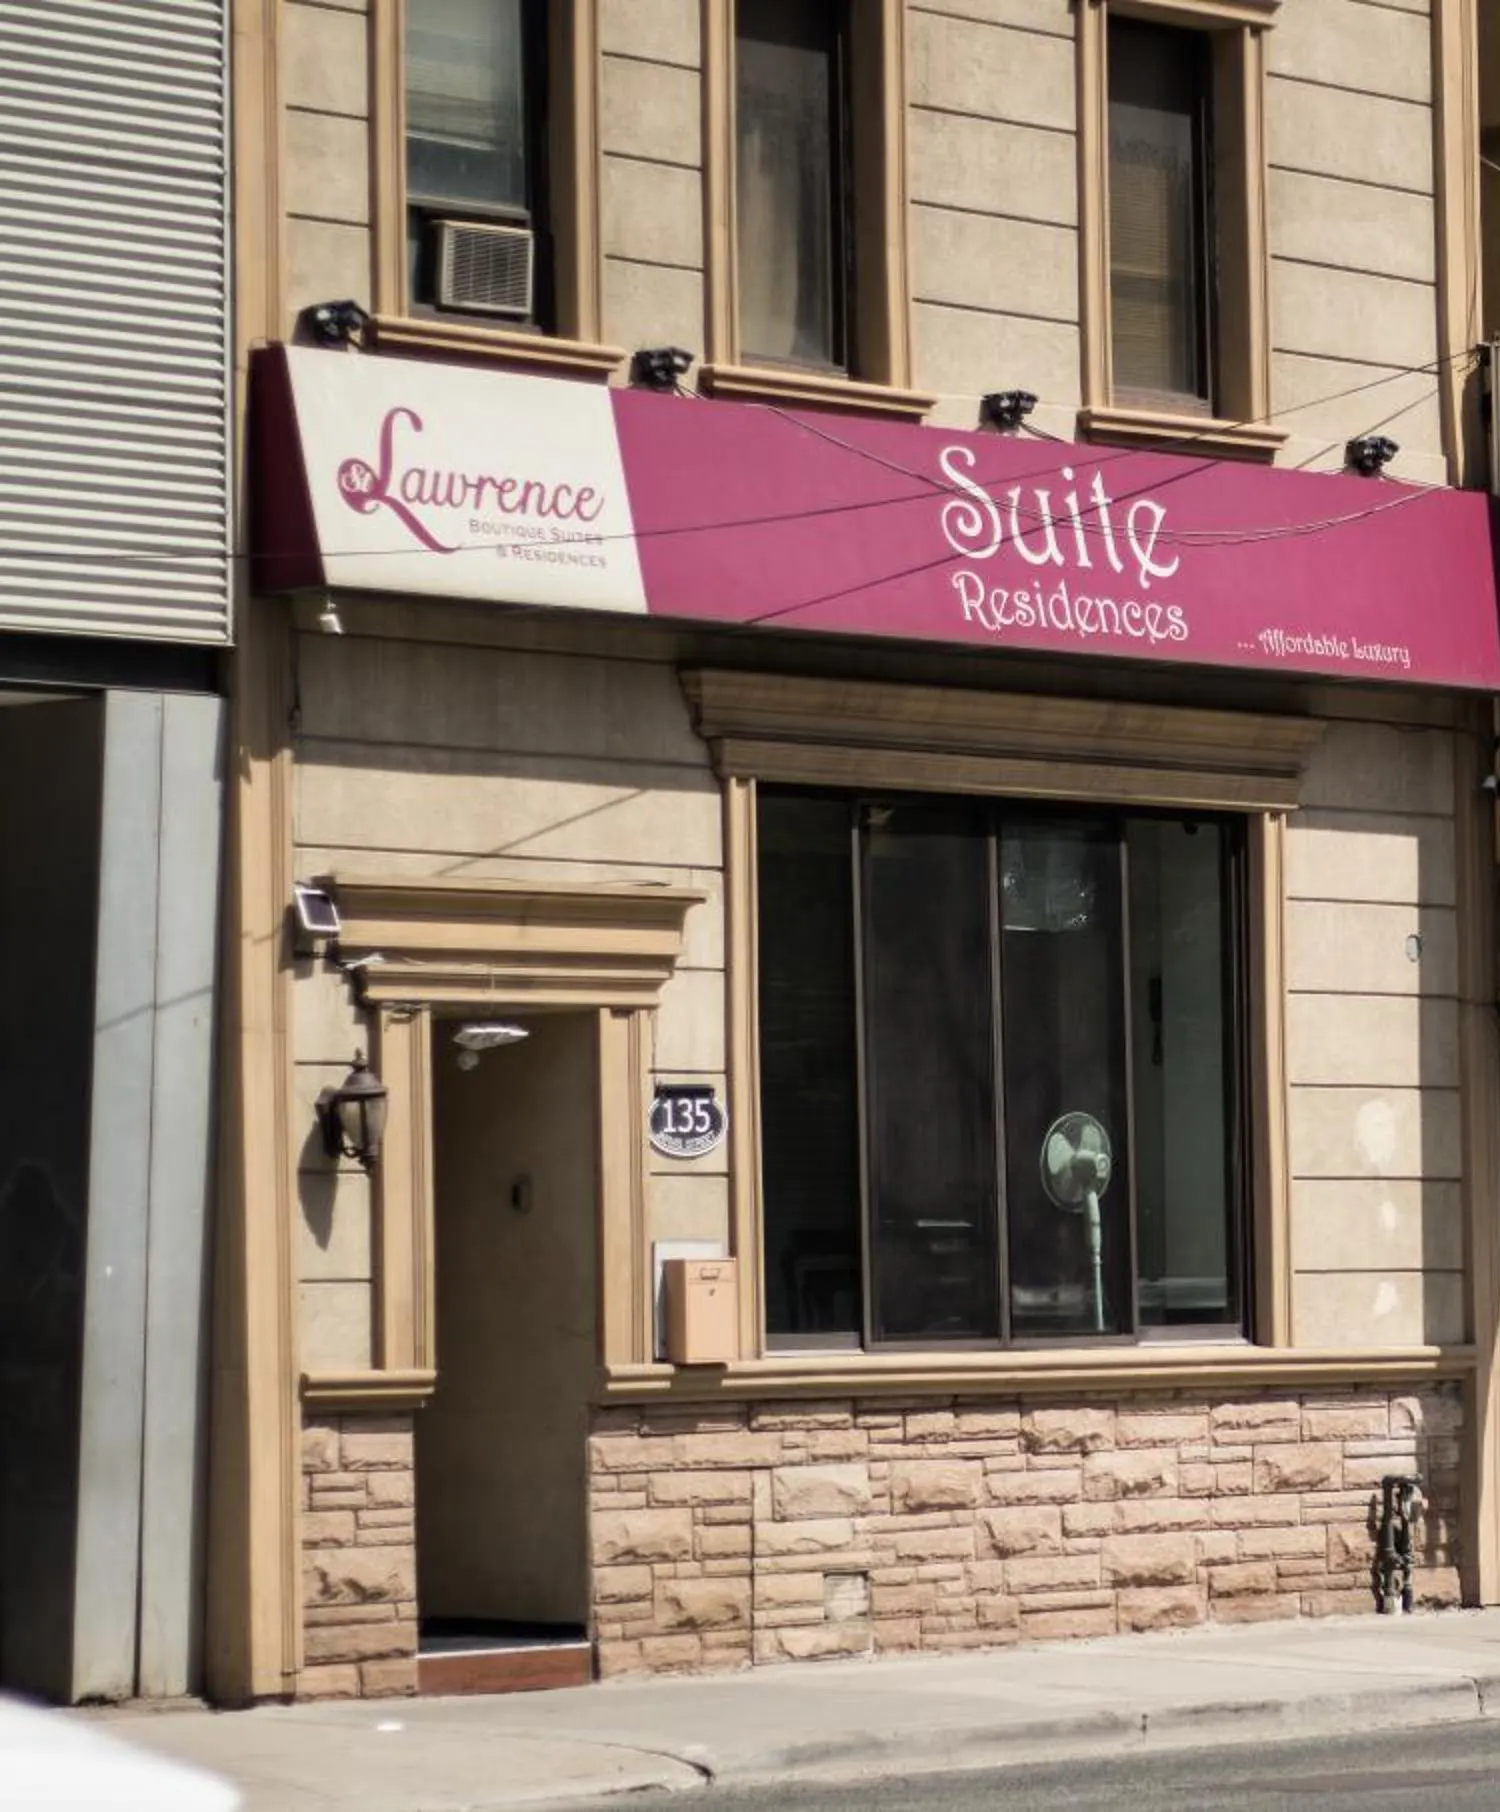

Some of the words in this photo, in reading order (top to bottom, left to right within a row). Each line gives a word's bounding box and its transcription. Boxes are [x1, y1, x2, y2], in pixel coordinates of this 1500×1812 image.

[338, 407, 604, 554] Lawrence
[938, 445, 1180, 588] Suite
[951, 570, 1190, 645] Residences
[1258, 628, 1350, 660] Affordable
[1352, 637, 1412, 670] Luxury
[663, 1097, 712, 1134] 135
